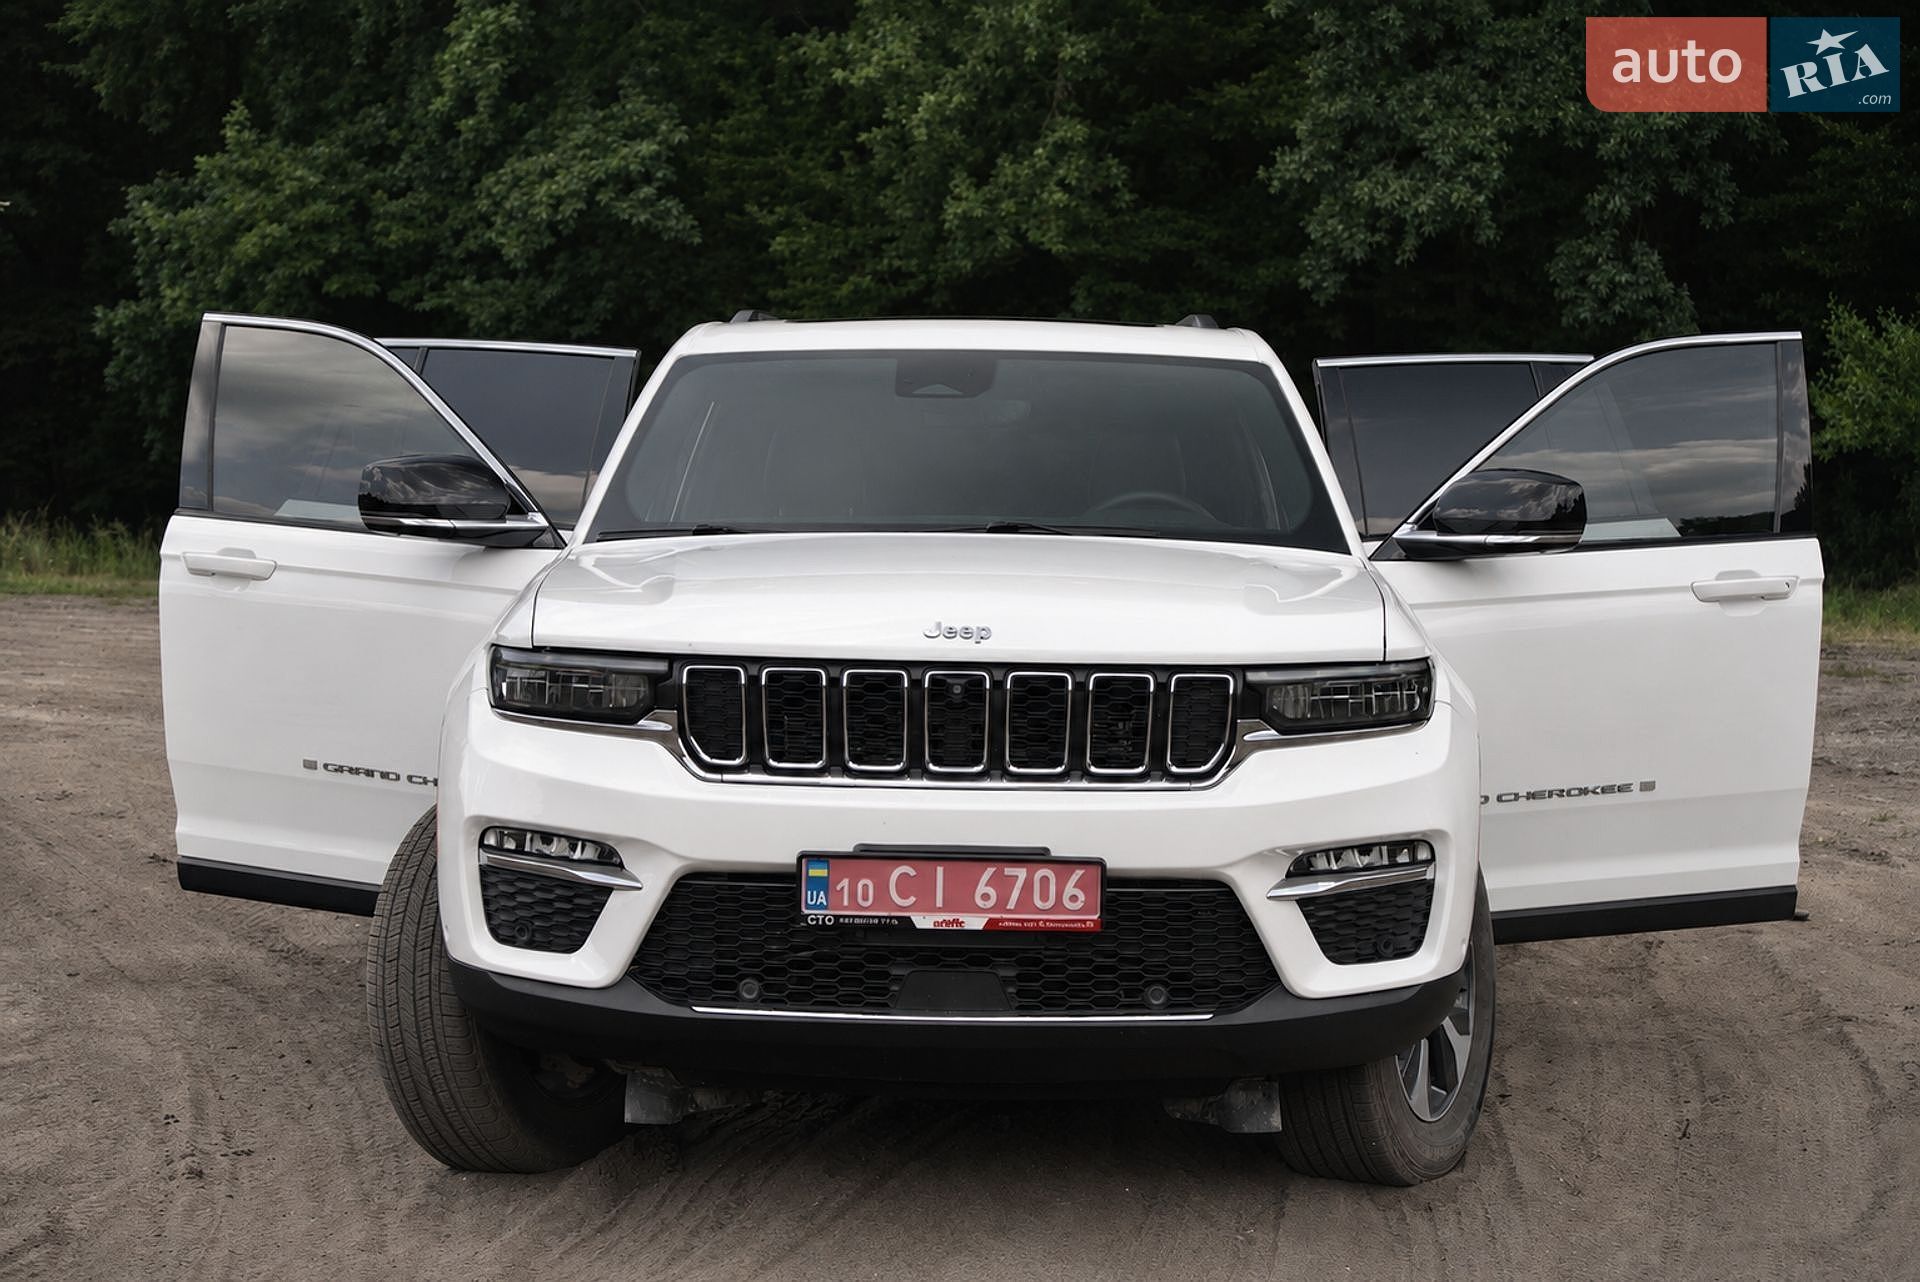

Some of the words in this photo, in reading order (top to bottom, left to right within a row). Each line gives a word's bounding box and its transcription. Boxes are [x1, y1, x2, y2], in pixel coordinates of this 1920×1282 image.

[923, 620, 992, 645] Jeep
[322, 762, 401, 782] GRAND
[1496, 782, 1634, 804] CHEROKEE
[806, 890, 828, 907] UA
[835, 877, 875, 909] 10
[973, 866, 1086, 911] 6706
